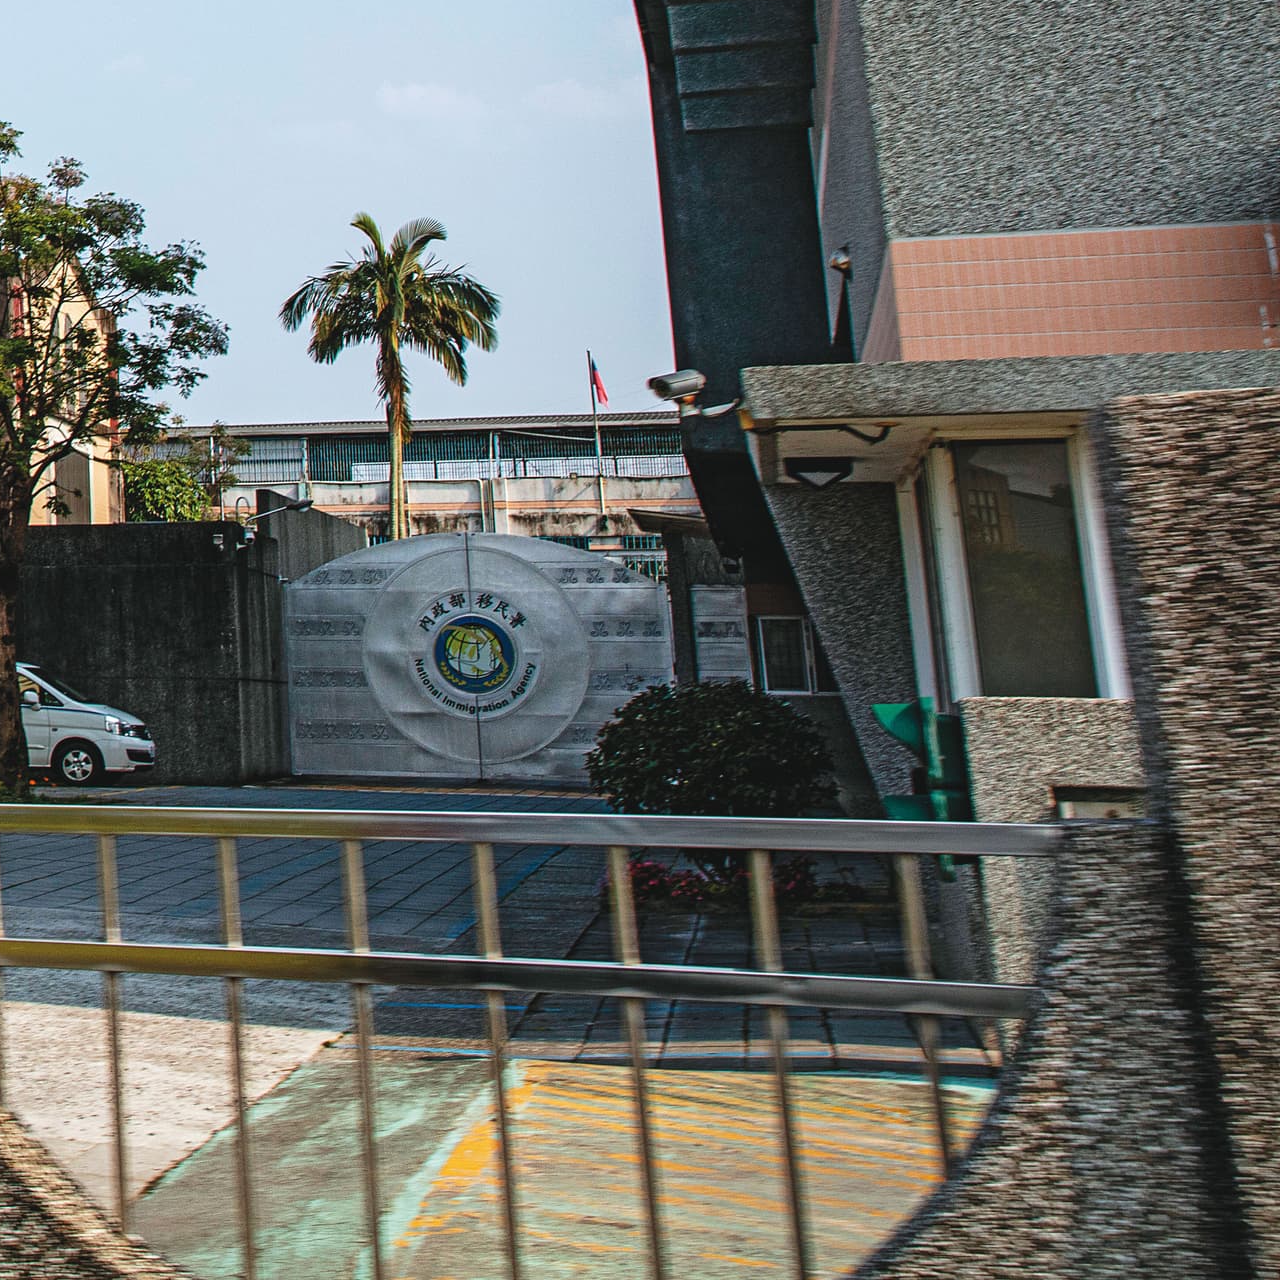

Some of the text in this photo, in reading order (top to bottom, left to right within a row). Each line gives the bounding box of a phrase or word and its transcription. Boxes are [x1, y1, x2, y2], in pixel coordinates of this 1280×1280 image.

[414, 659, 537, 714] National Immigration Agency
